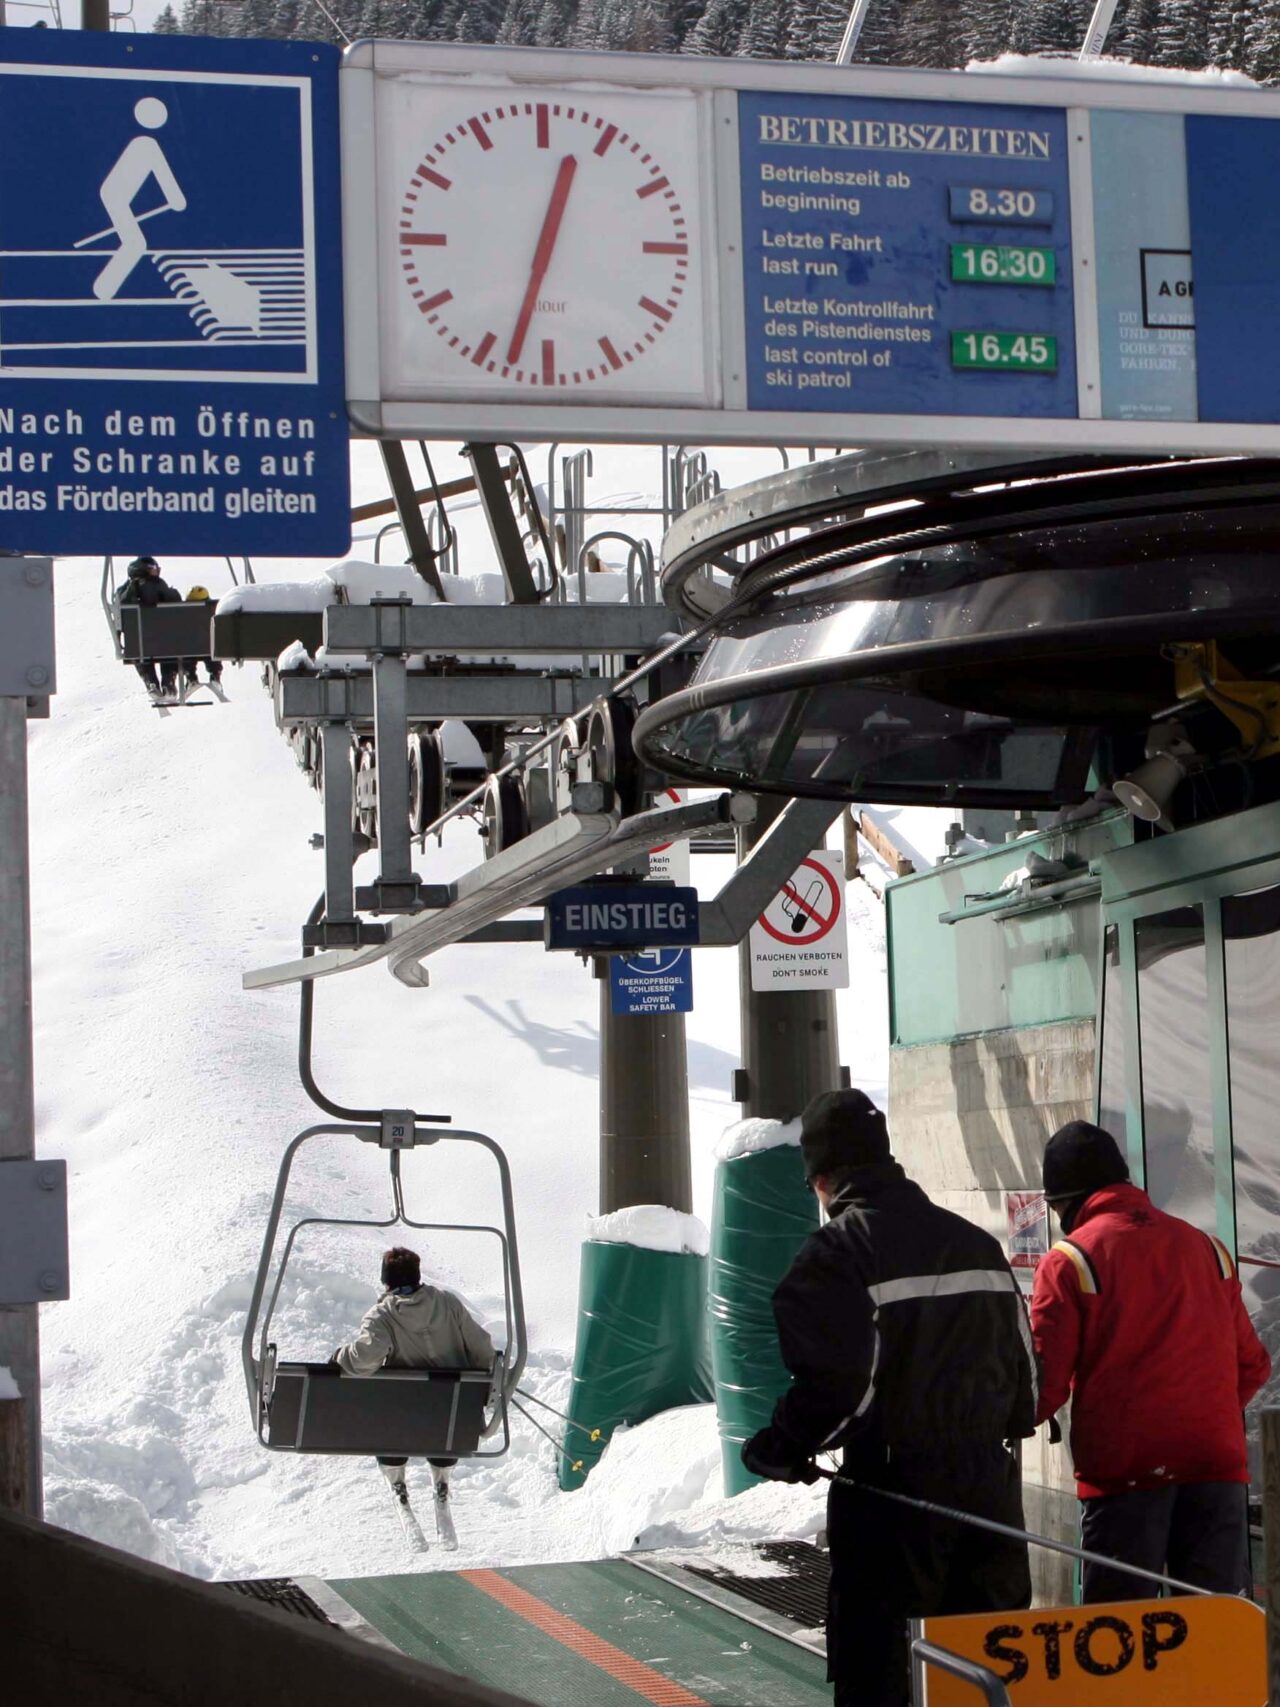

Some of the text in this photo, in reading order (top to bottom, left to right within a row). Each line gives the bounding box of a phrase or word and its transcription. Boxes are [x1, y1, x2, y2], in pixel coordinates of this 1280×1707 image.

[758, 115, 1050, 158] BETRIEBSZEITEN
[760, 164, 910, 189] Betriebszeit ab
[761, 191, 861, 216] beginning
[969, 189, 1036, 217] 8.30
[762, 230, 882, 252] Letzte Fahrt
[762, 256, 839, 276] last run
[962, 248, 1045, 278] 16.30
[764, 296, 934, 320] Letzte Kontrollfahrt
[764, 320, 932, 342] des Pistendienstes
[765, 346, 891, 367] last control of
[963, 335, 1049, 364] 16.45
[766, 369, 851, 389] ski patrol
[0, 406, 315, 438] Nach dem Öffnen
[73, 447, 241, 475] Schranke
[260, 451, 315, 476] auf
[57, 485, 215, 512] Förderband
[224, 487, 316, 518] gleiten
[565, 902, 686, 930] EINSTIEG
[756, 952, 843, 962] RAUCHEN VERBOTEN
[618, 976, 684, 986] ÜBERKOPFBÜGEL
[772, 968, 829, 978] DON'T SMOKE
[628, 985, 675, 994] SCHLIESSEN
[642, 995, 670, 1004] LOWER
[629, 1003, 676, 1012] SAFETY BAR
[392, 1126, 405, 1137] 20
[983, 1611, 1188, 1686] STOP
